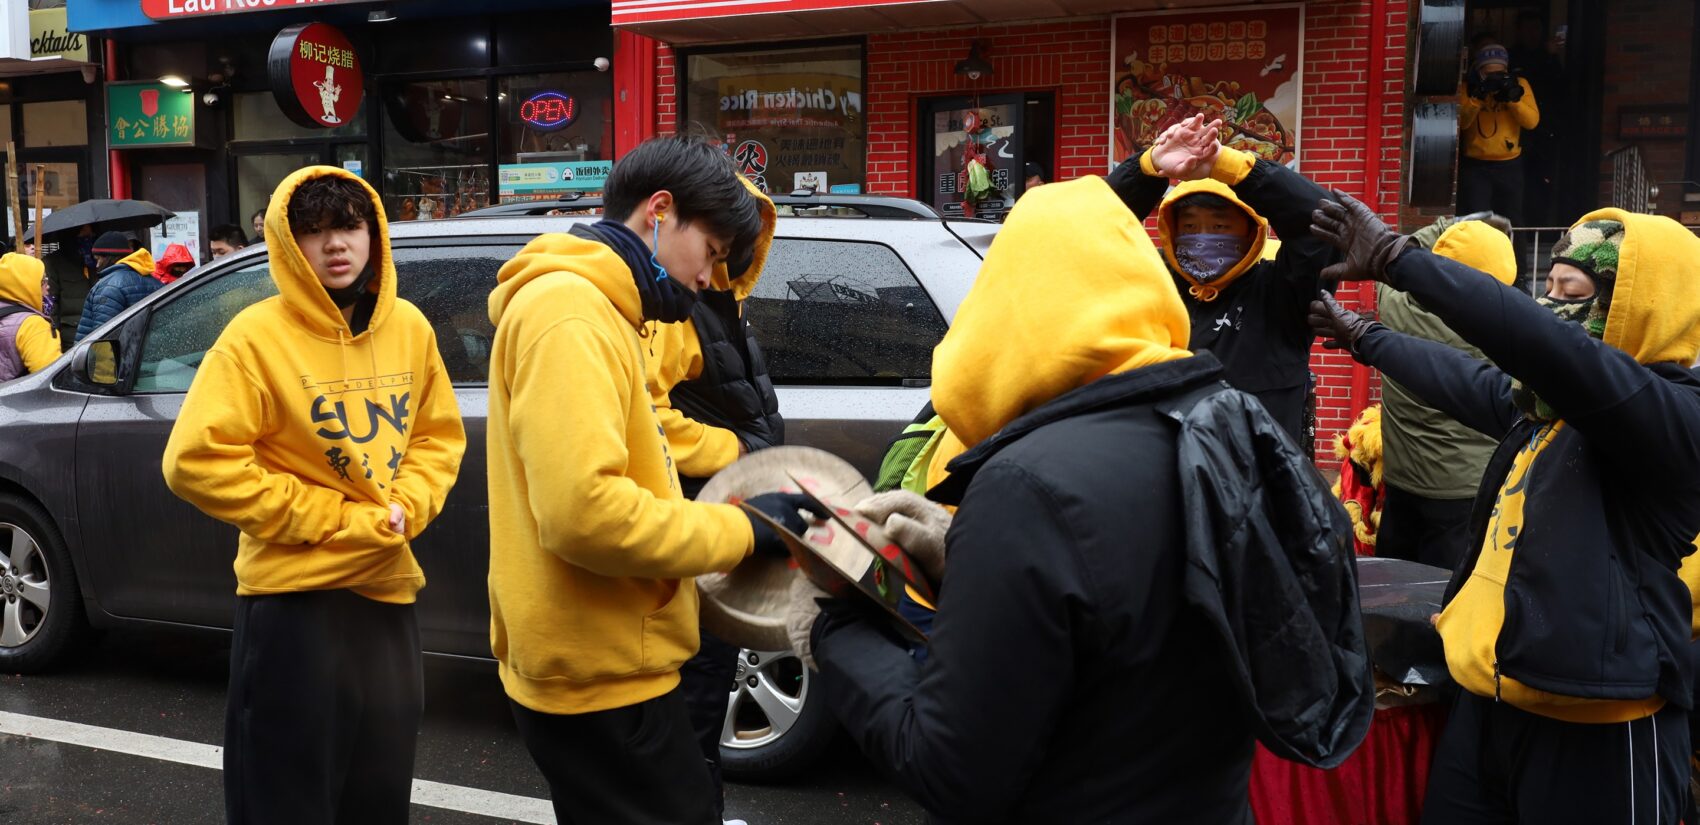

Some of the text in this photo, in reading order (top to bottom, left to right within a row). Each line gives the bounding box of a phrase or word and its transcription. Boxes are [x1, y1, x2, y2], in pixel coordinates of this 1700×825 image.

[30, 27, 82, 54] cktails
[300, 40, 354, 69] 柳记烧腊
[520, 96, 574, 121] OPEN
